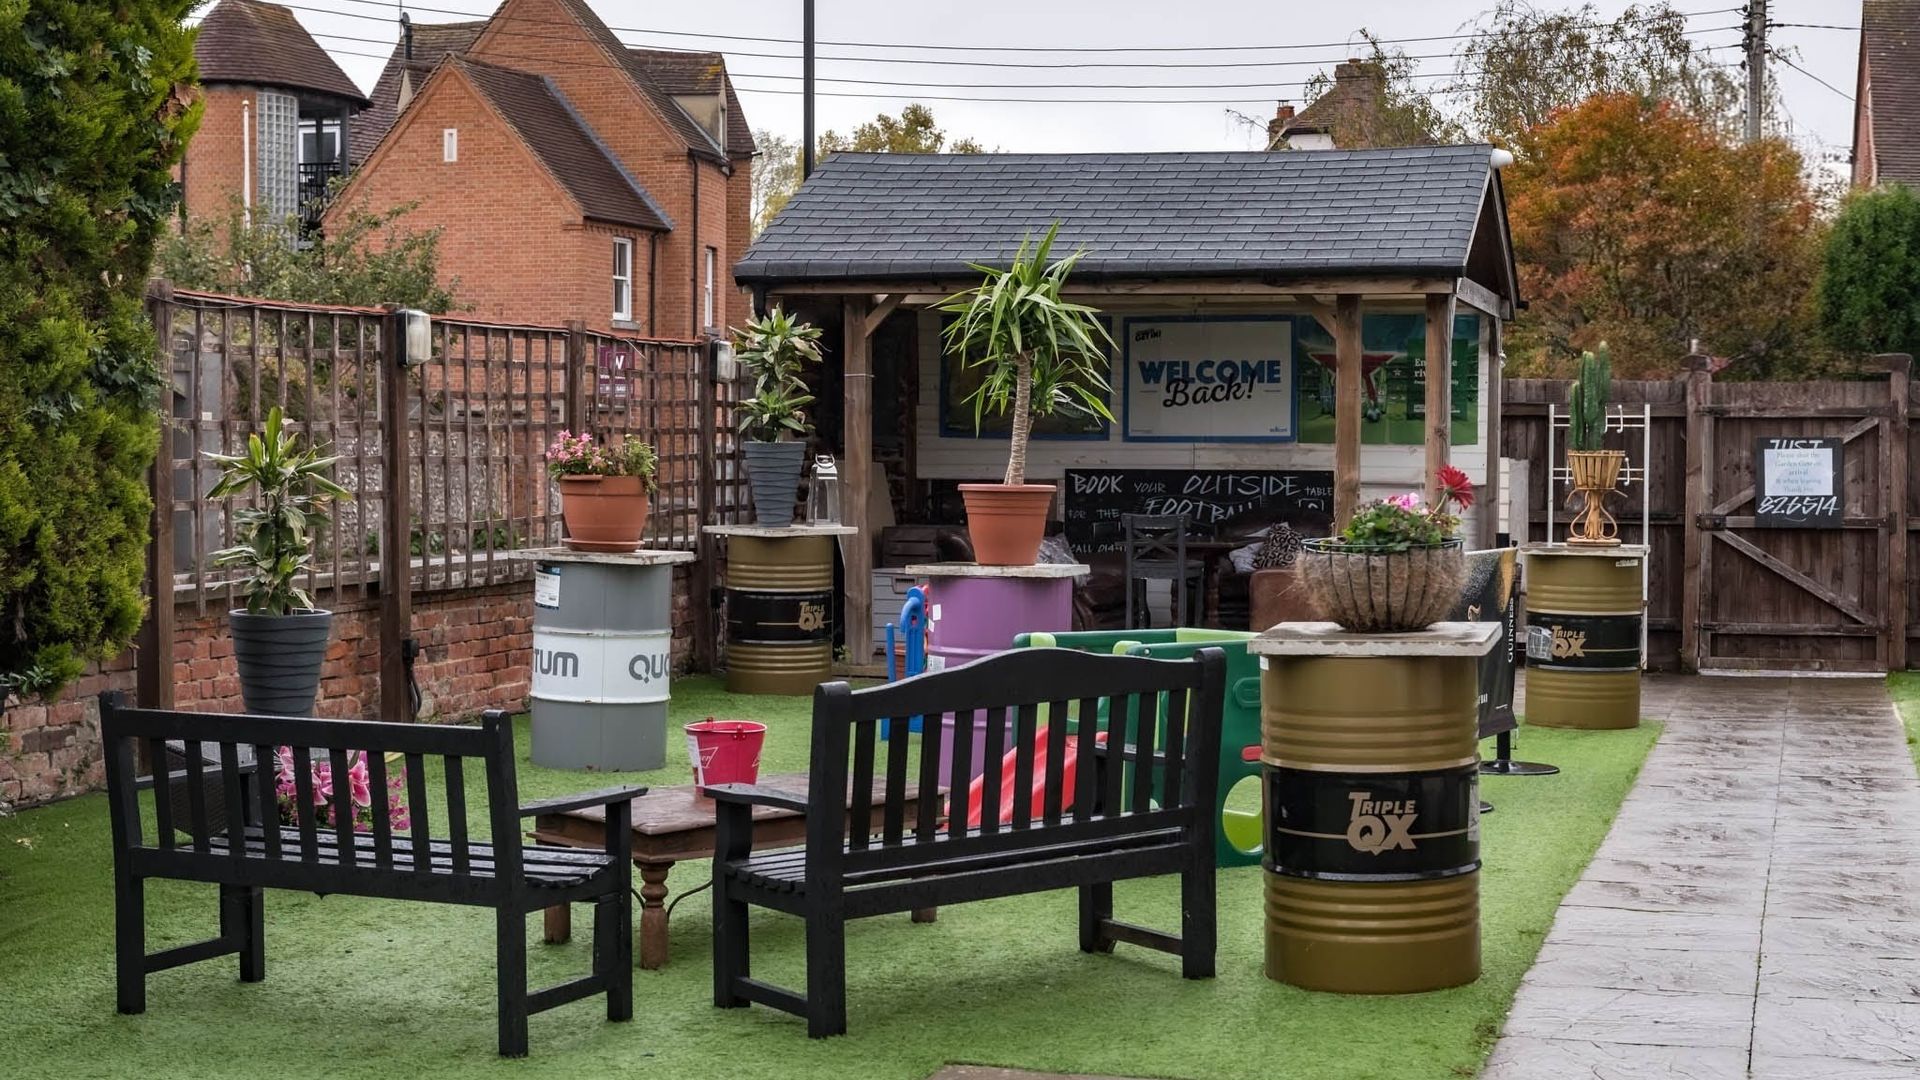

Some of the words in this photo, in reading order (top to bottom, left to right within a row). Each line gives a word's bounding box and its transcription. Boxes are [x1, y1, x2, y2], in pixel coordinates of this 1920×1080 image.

[1137, 359, 1281, 385] WELCOME
[1162, 367, 1258, 408] Back!
[1070, 473, 1125, 494] BOOK
[1134, 483, 1167, 494] YOUR
[1183, 475, 1301, 496] OUTSIDE
[1096, 508, 1120, 520] THE
[1757, 496, 1840, 516] 826514
[1551, 625, 1585, 639] TRIPLE
[1348, 791, 1417, 816] TRIPLE
[1346, 813, 1419, 856] QX
